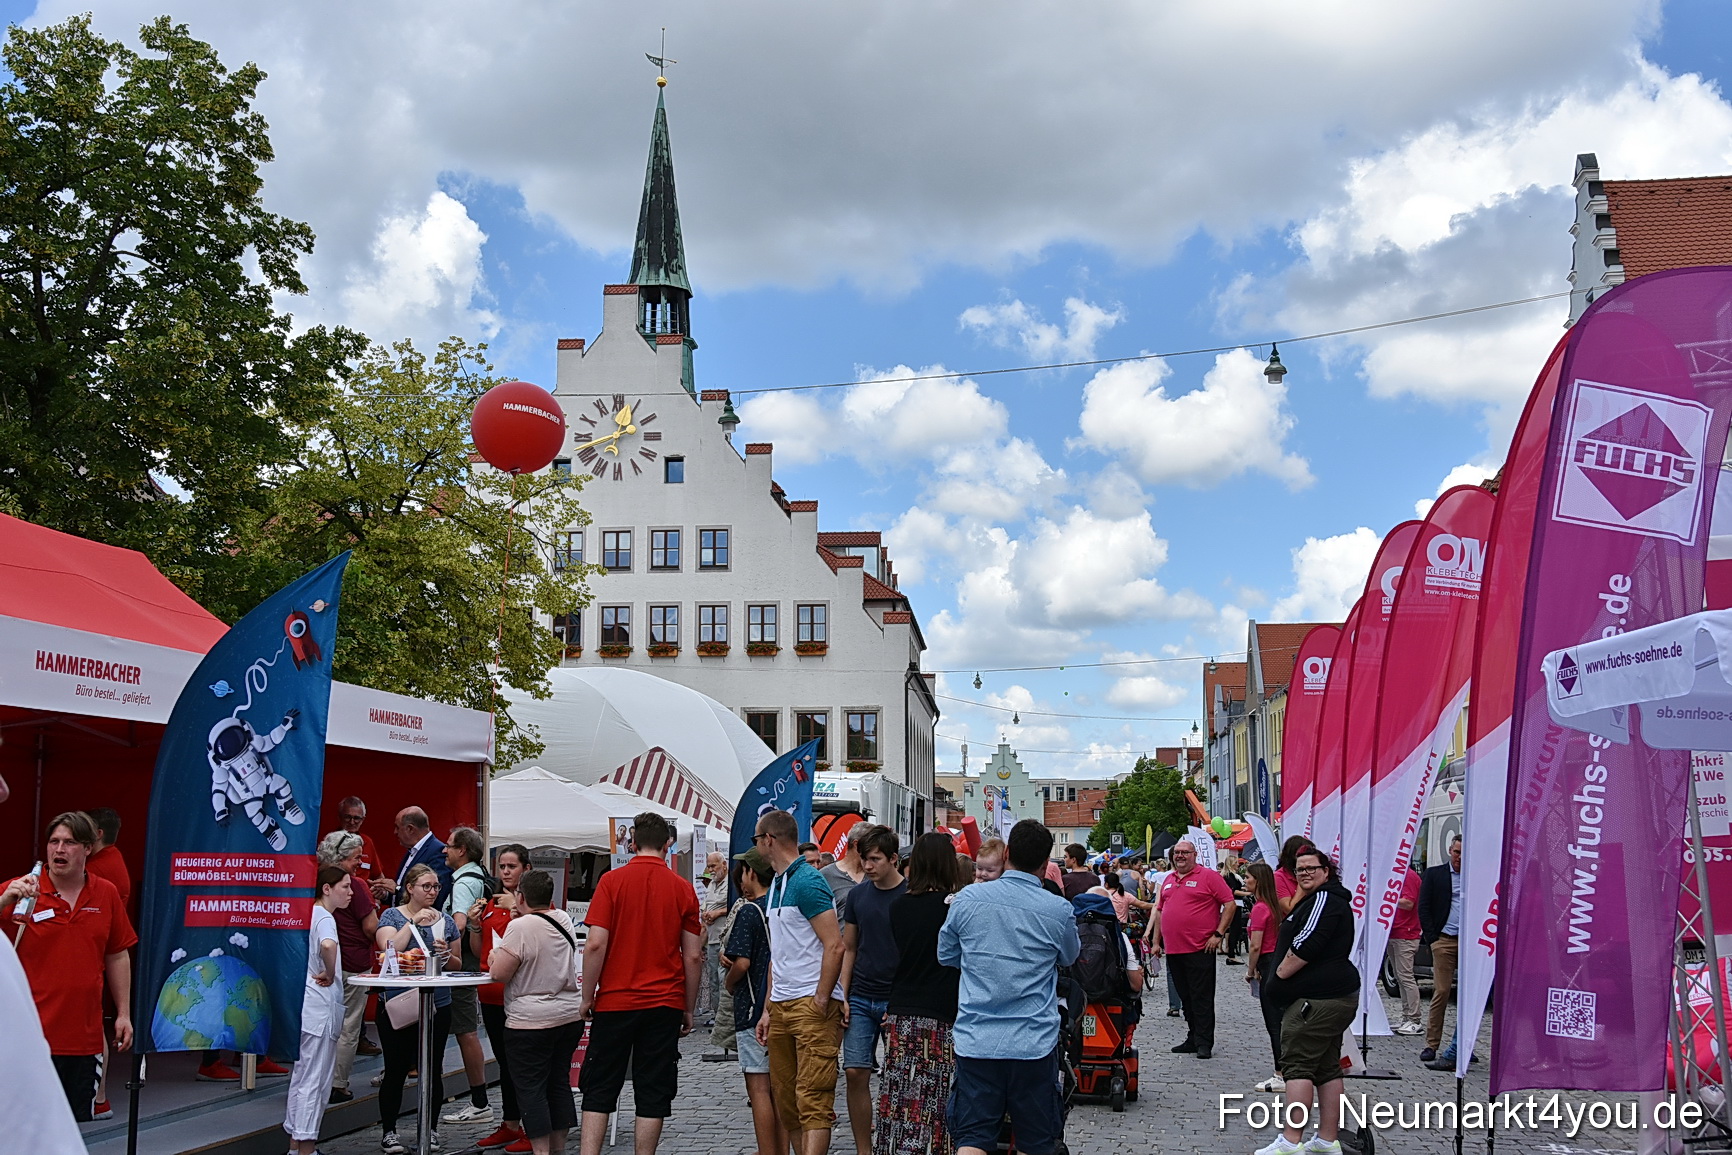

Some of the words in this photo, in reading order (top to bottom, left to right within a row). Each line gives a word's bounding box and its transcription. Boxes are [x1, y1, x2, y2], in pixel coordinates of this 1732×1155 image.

[503, 402, 561, 425] HAMMERBACHER
[1574, 440, 1696, 484] FUCHS
[1428, 567, 1456, 577] KLEBE
[1459, 570, 1481, 580] TECH
[35, 650, 141, 685] HAMMERBACHER
[1557, 667, 1579, 680] FUCHS
[1585, 641, 1683, 675] www.fuchs-soehne.de
[75, 684, 92, 697] Büro
[94, 687, 120, 701] bestel...
[121, 692, 152, 706] geliefert.
[369, 707, 423, 730] HAMMERBACHER
[1520, 725, 1564, 820] ZUKUN
[1704, 770, 1724, 781] We
[813, 782, 836, 793] RA
[175, 857, 222, 867] NEUGIERIG
[224, 858, 244, 868] AUF
[246, 858, 275, 869] UNSER
[616, 857, 630, 865] Busi
[174, 870, 295, 883] BÜROMÖBEL-UNIVERSUM?
[1376, 878, 1402, 931] JOBS
[1392, 838, 1412, 877] MIT
[189, 900, 290, 915] HAMMERBACHER
[230, 915, 247, 923] Büro
[271, 918, 303, 927] geliefert.
